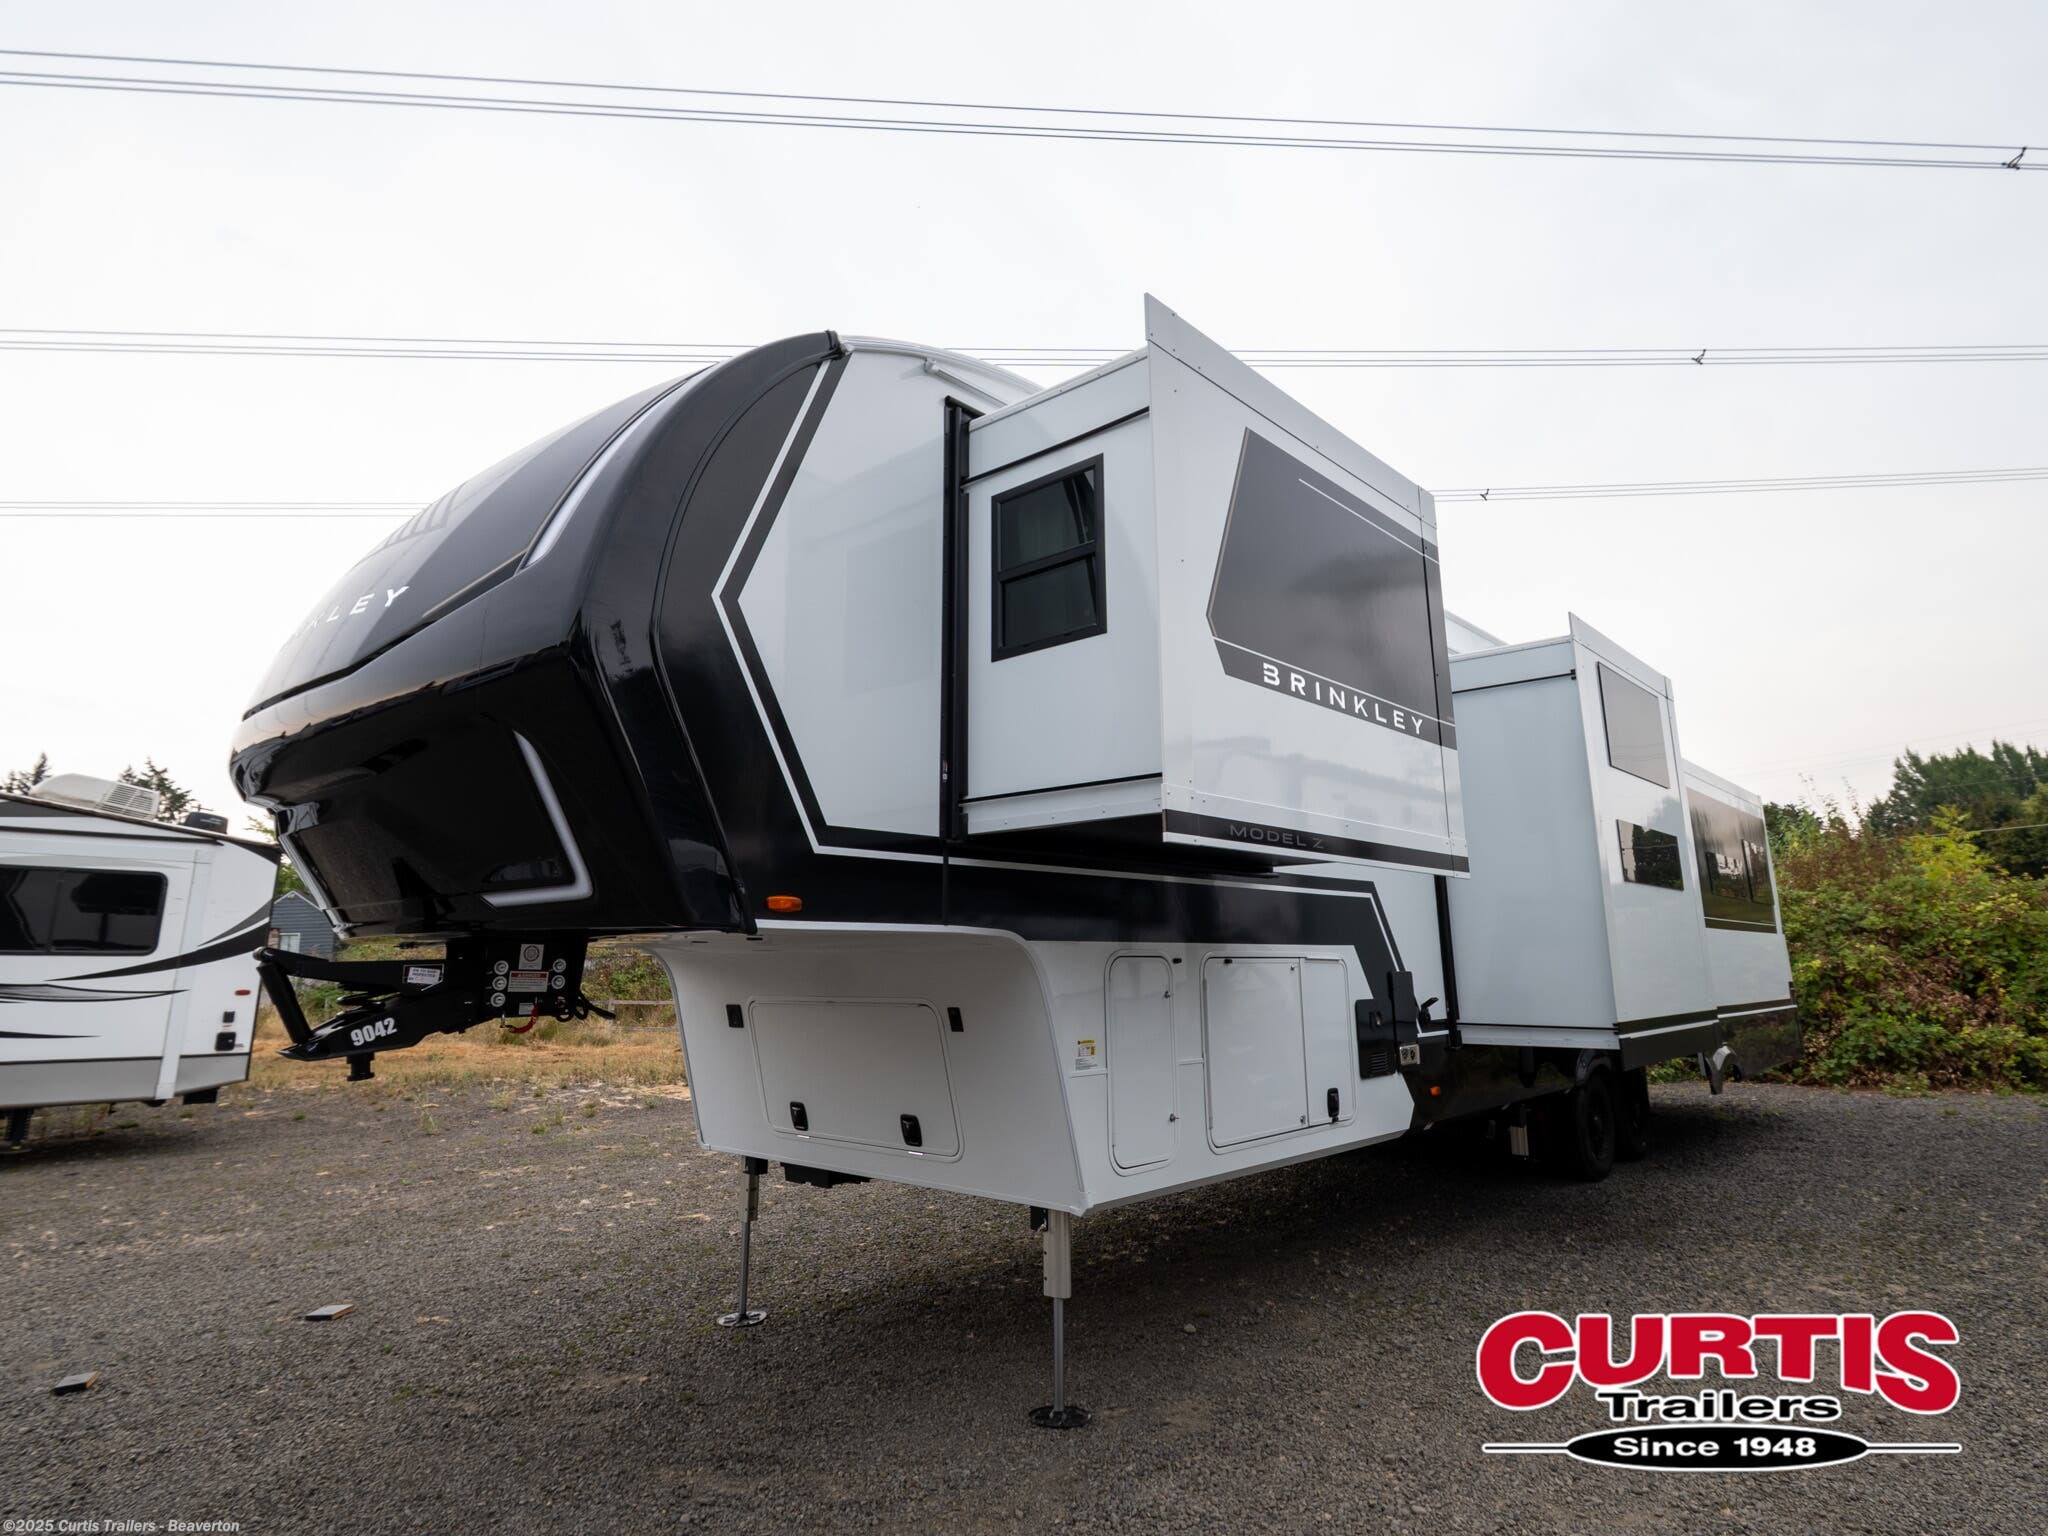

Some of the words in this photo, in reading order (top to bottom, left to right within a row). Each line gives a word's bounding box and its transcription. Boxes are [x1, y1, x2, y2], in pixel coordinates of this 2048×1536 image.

[1263, 662, 1424, 735] BRINKLEY
[1229, 824, 1308, 847] MODEL
[1312, 837, 1325, 849] Z
[350, 1017, 398, 1046] 9042
